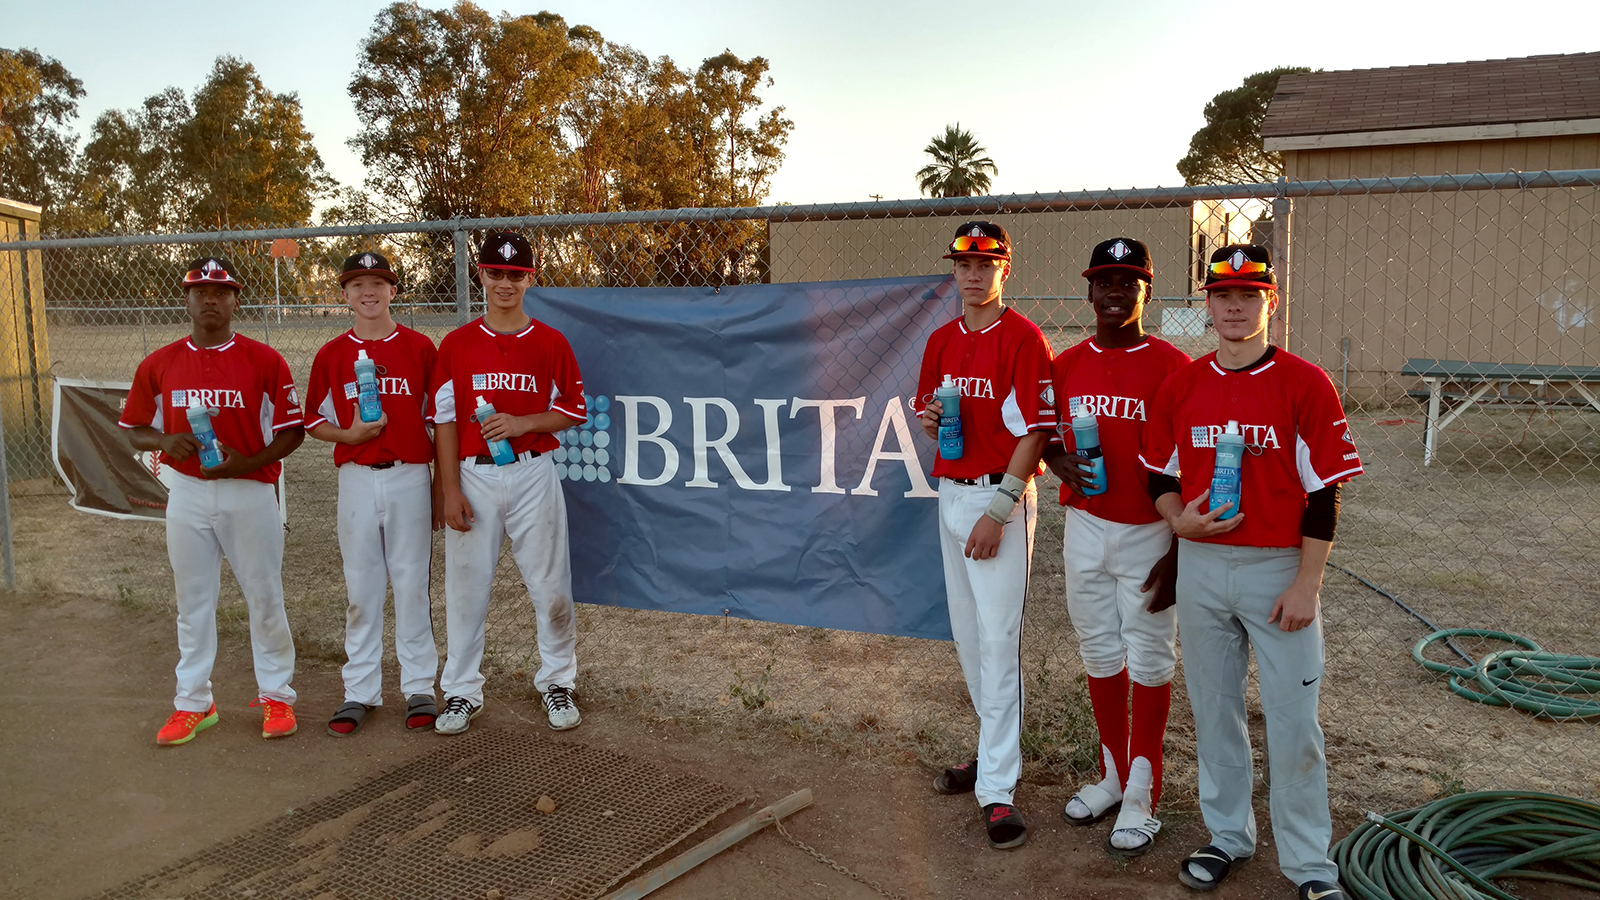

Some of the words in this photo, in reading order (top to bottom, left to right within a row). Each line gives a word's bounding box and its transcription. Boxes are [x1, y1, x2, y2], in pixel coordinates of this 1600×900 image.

[376, 377, 412, 396] ITA
[486, 372, 538, 393] BRITA
[1081, 395, 1147, 421] BRITA
[615, 395, 940, 498] BRITA
[1208, 425, 1281, 449] BITA
